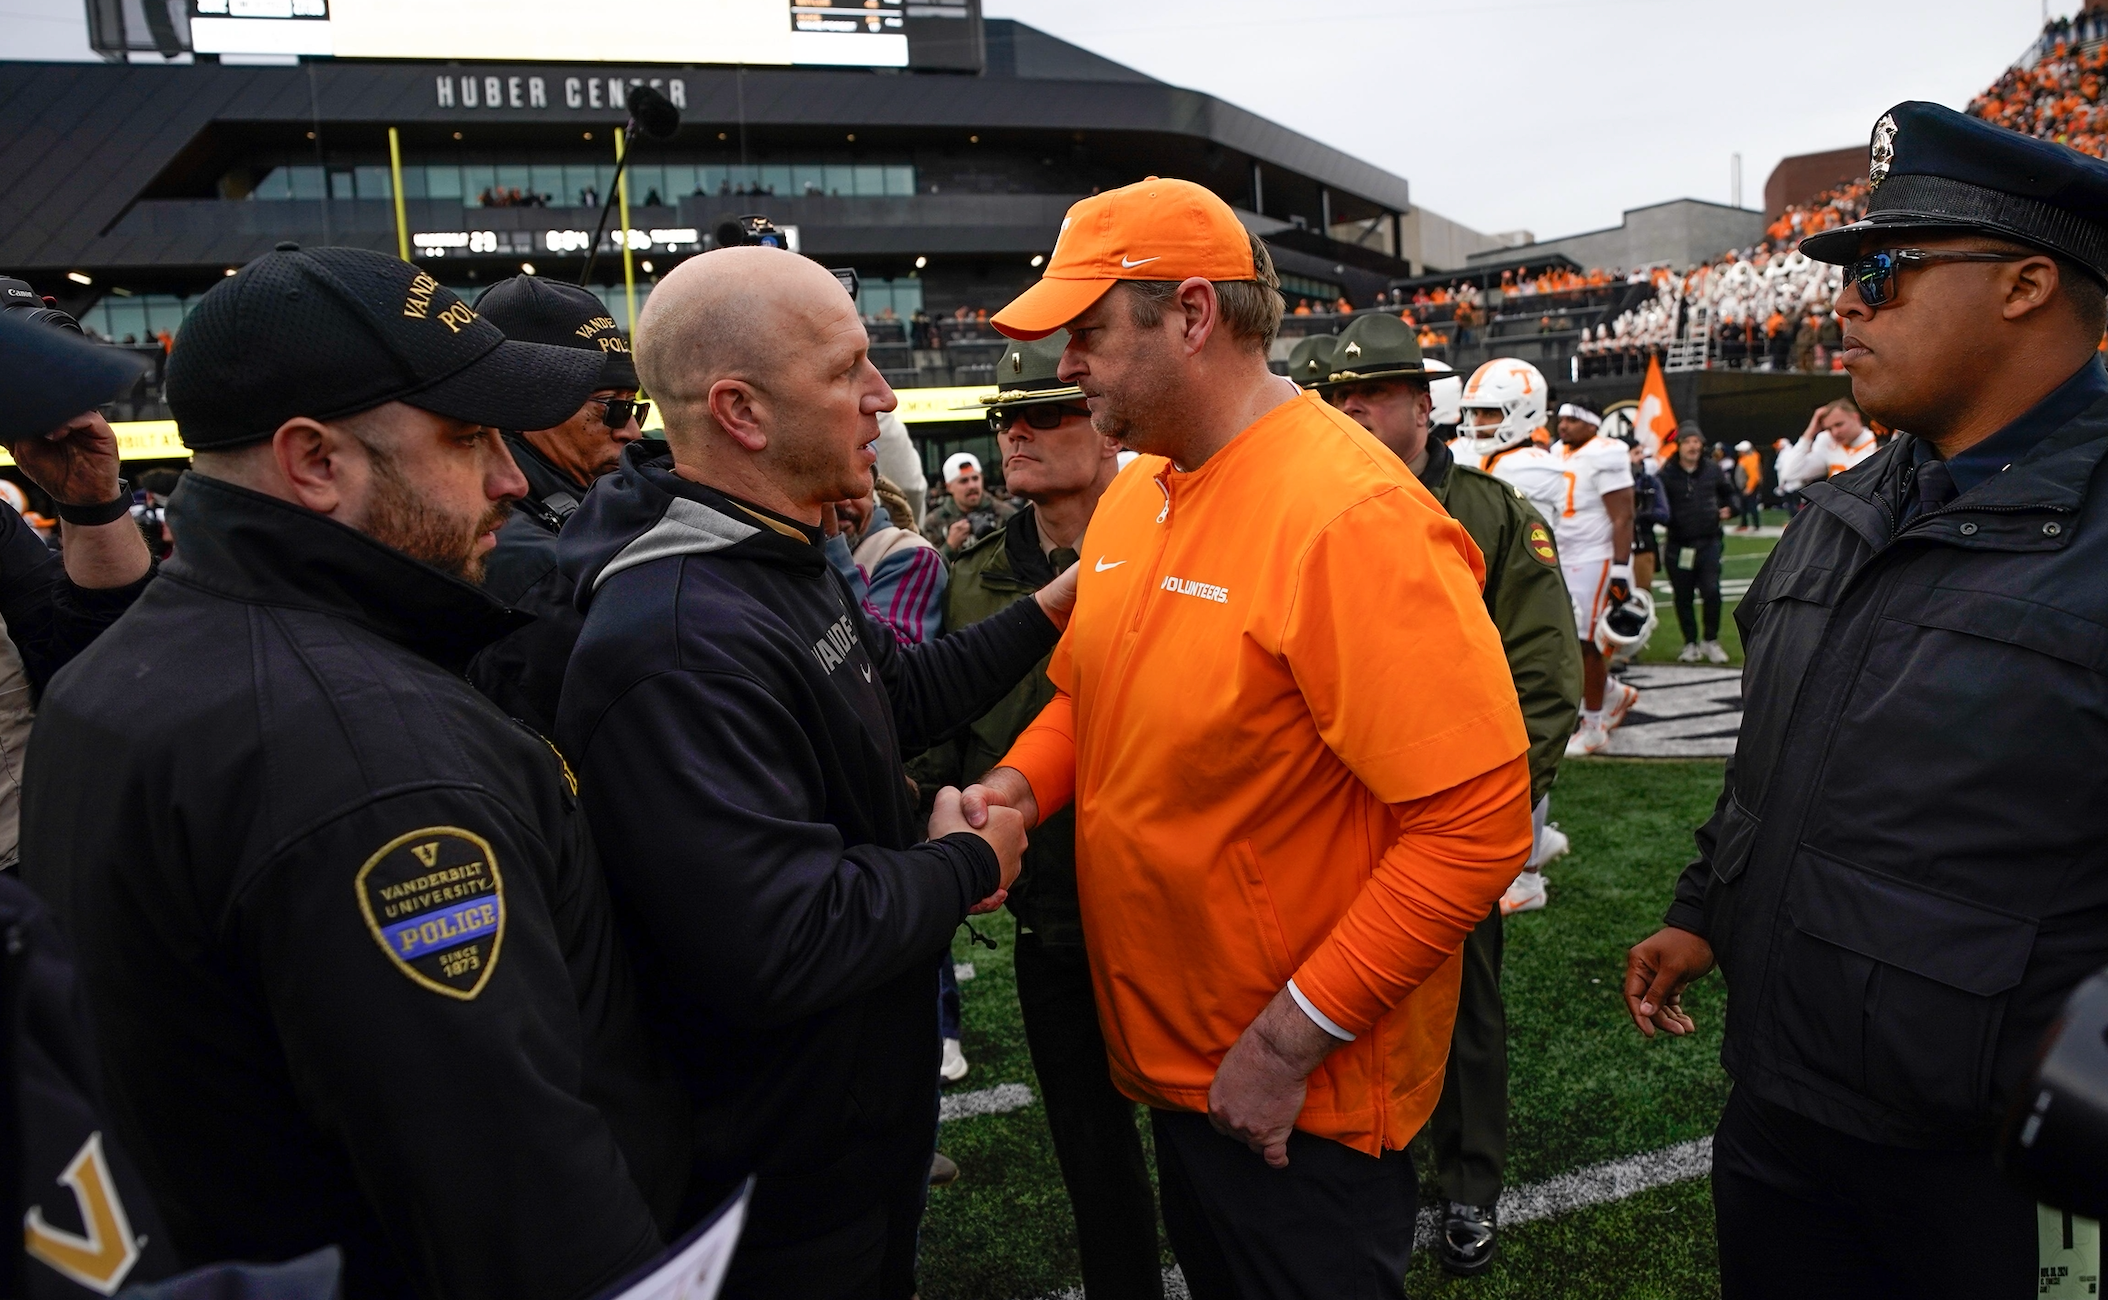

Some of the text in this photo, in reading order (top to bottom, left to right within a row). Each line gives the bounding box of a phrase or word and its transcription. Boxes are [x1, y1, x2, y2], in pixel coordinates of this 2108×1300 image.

[436, 75, 688, 110] HUBER CENR
[7, 288, 33, 298] Canon
[410, 842, 440, 868] V
[378, 861, 484, 901] VANDERBILT
[384, 877, 488, 918] UNIVERSITY
[397, 903, 497, 951] POLICE
[438, 944, 480, 967] SINCE
[443, 955, 482, 979] 1873
